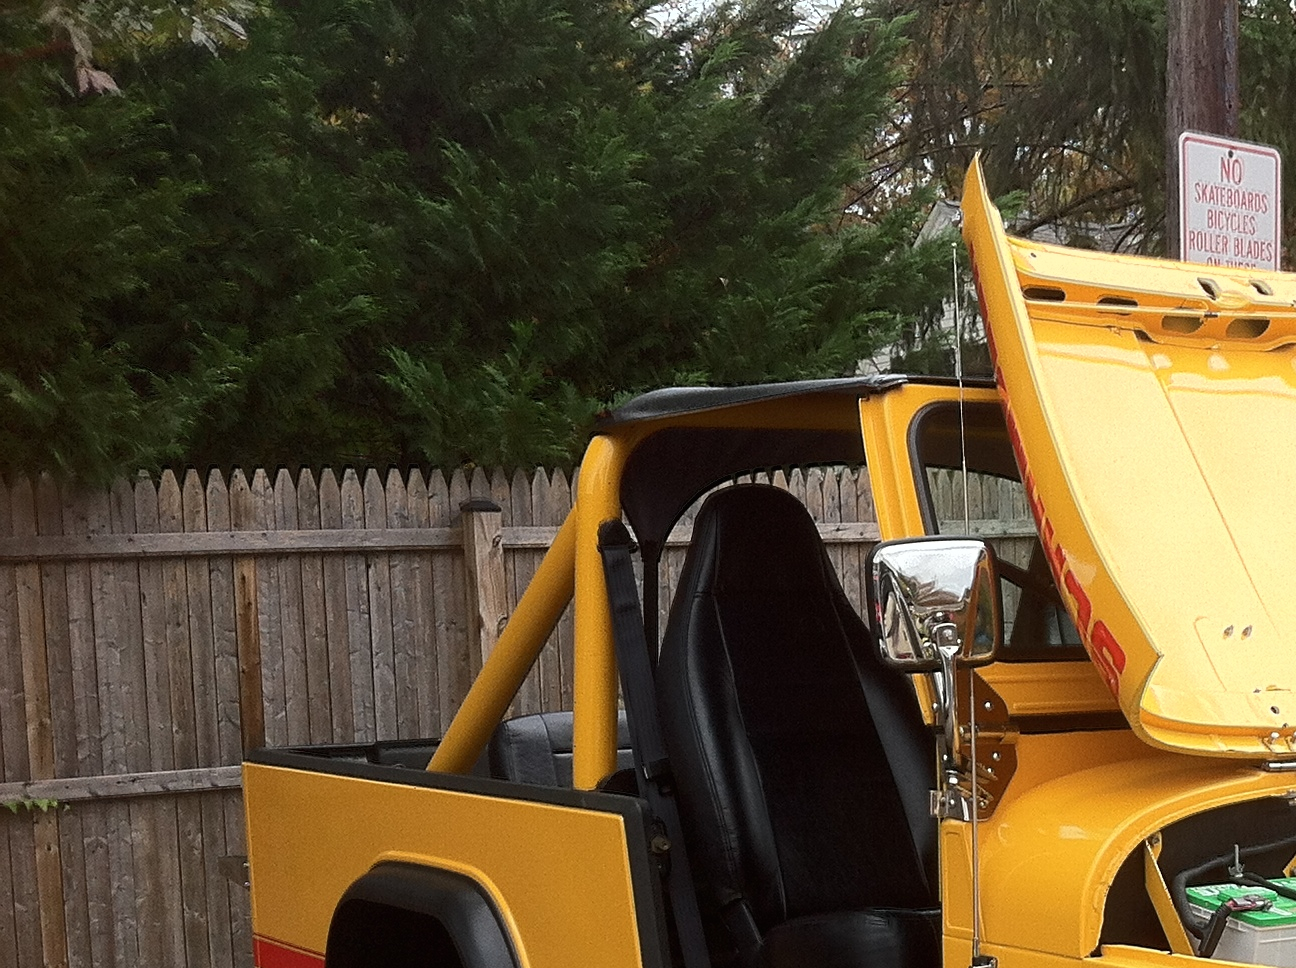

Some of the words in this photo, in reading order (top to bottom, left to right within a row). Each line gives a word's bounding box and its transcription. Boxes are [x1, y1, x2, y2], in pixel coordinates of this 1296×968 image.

[1220, 157, 1244, 185] NO
[1194, 183, 1268, 214] SKATEBOARDS
[1207, 209, 1256, 236] BICYCLES
[1189, 231, 1228, 256] ROLLER
[1234, 237, 1272, 262] BLADES
